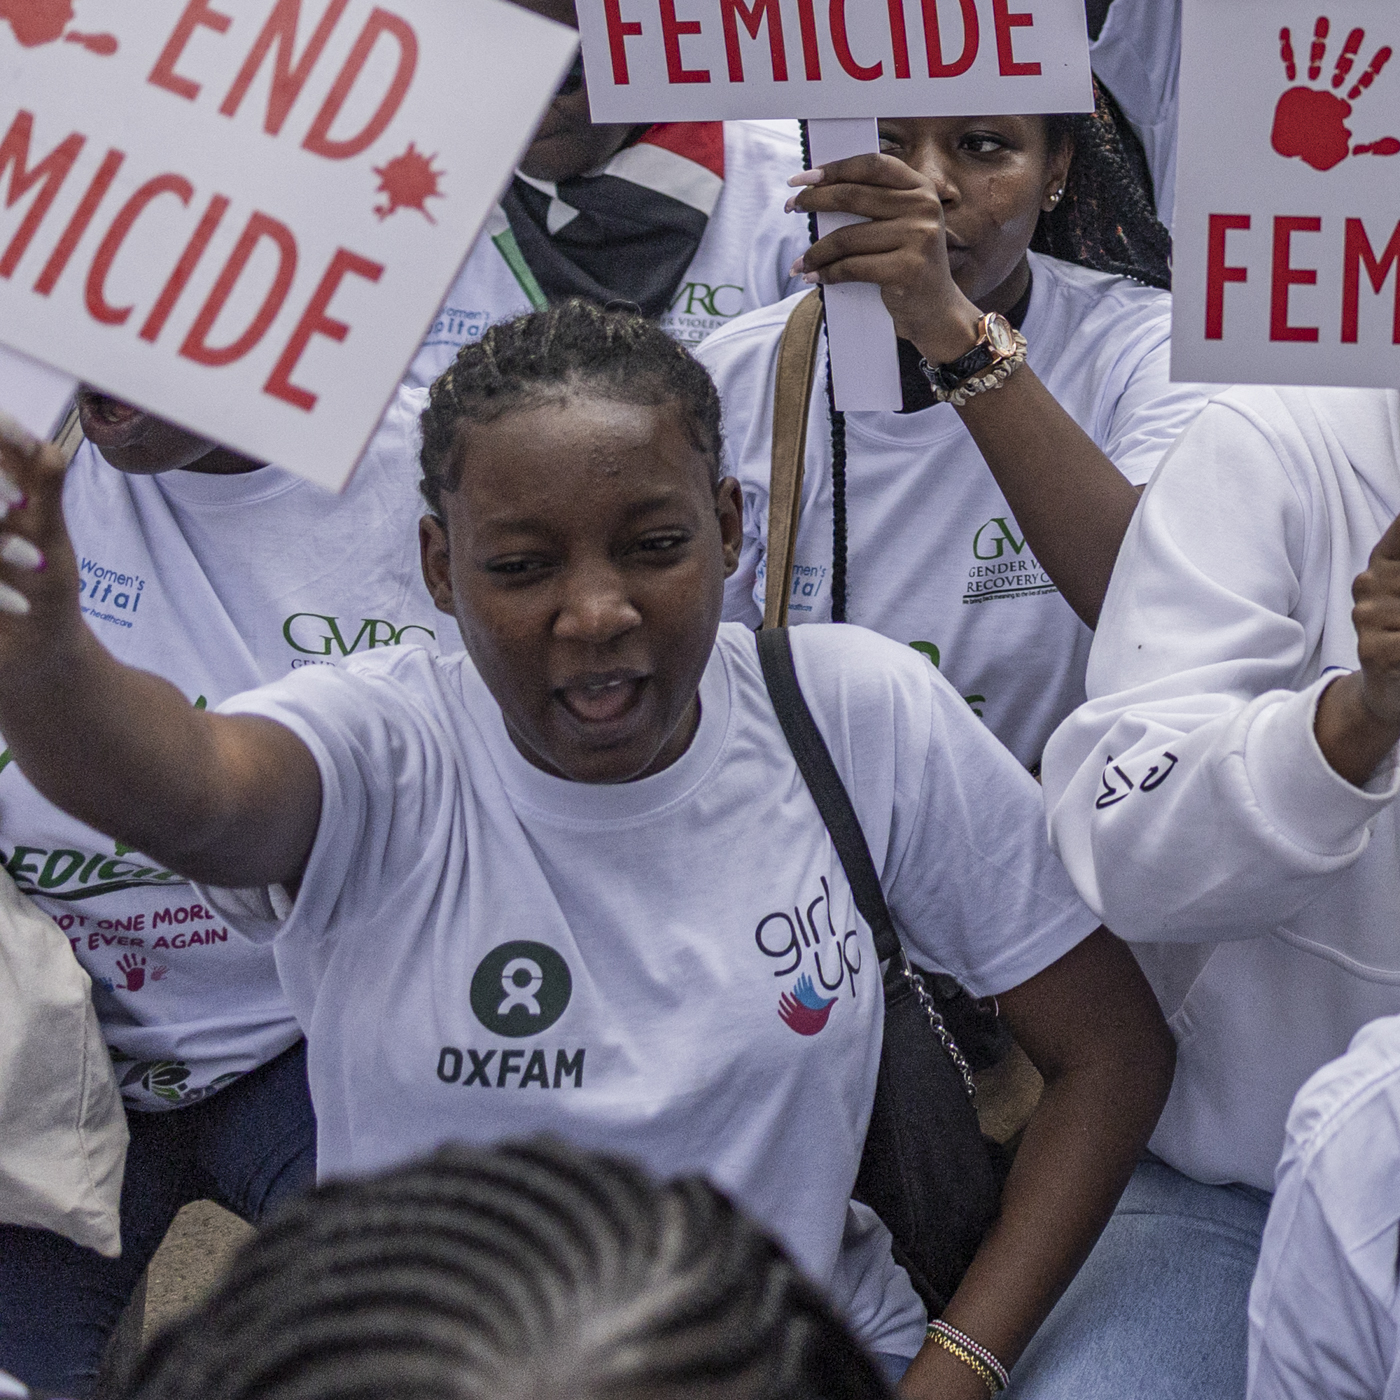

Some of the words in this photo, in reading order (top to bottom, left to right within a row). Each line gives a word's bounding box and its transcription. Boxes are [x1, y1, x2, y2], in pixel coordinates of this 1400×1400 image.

[80, 557, 146, 592] Women's
[966, 572, 1039, 593] RECOVERY
[969, 559, 1028, 578] GENDER
[96, 912, 147, 932] ONE
[755, 875, 835, 978] girl
[87, 931, 146, 954] EVER
[152, 925, 230, 953] AGAIN
[812, 930, 862, 999] up
[436, 1045, 587, 1090] OXFAM
